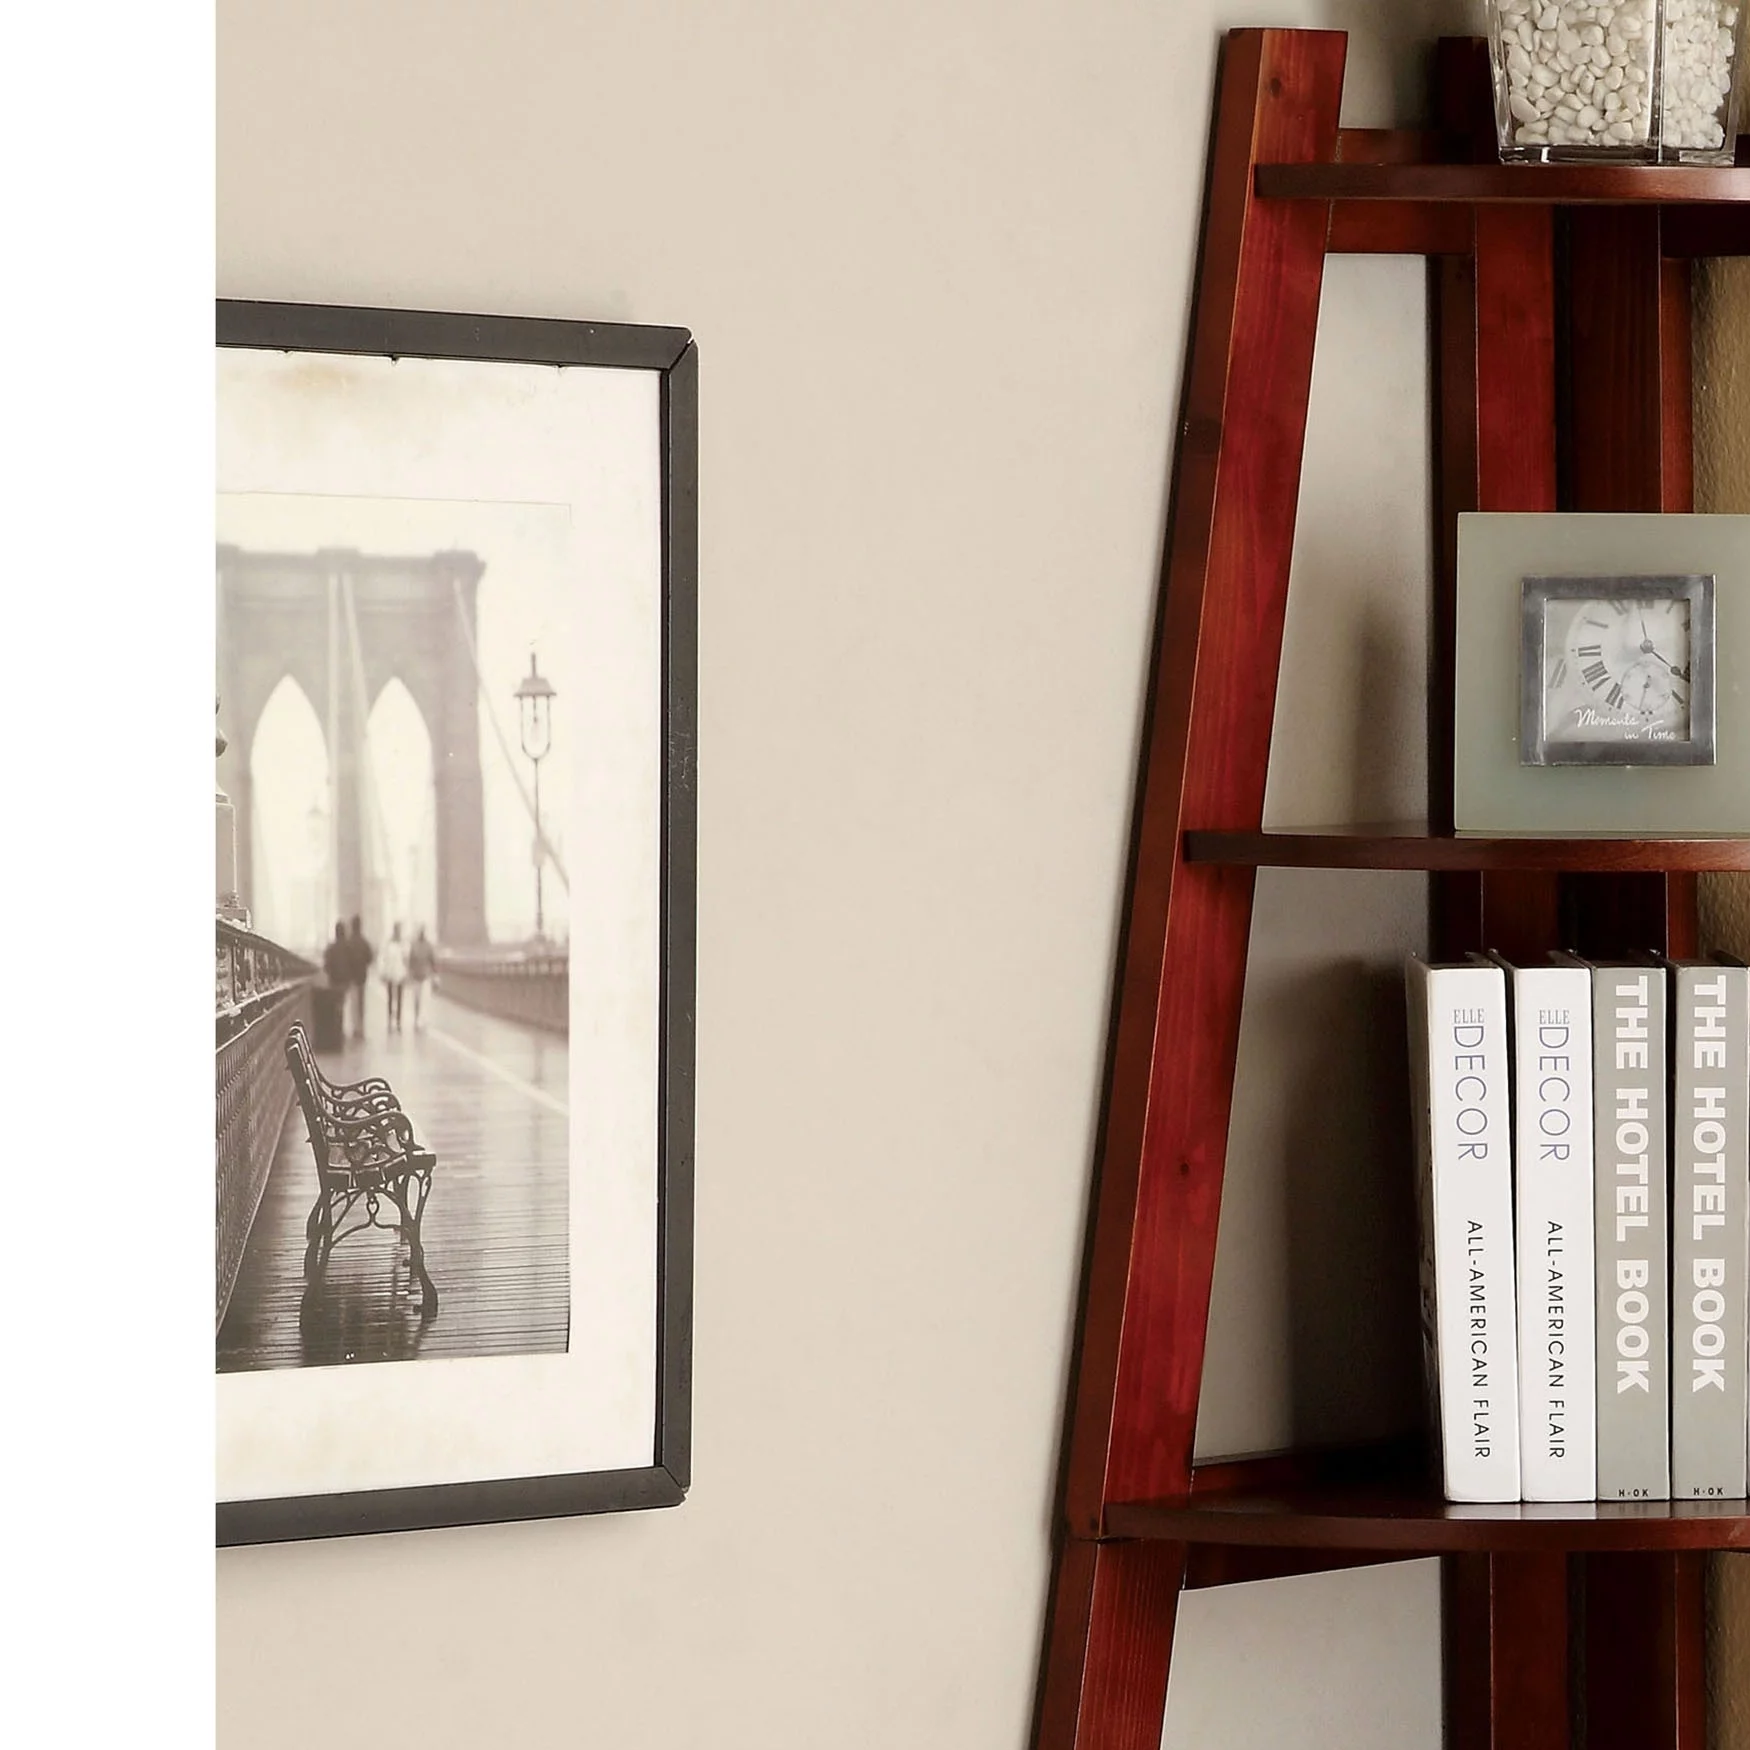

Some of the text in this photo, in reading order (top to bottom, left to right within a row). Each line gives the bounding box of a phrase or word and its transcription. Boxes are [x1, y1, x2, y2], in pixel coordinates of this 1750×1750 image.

[1453, 1008, 1485, 1024] ELLE
[1454, 1026, 1488, 1161] DECOR
[1539, 1009, 1571, 1025] ELLE
[1539, 1026, 1571, 1161] DECOR
[1615, 976, 1650, 1394] THE HOTEL BOOK
[1692, 976, 1726, 1392] THE HOTEL BOOK
[1467, 1220, 1490, 1459] ALL-AMERICAN FLAIR
[1548, 1220, 1565, 1459] ALL-AMERICAN FLAIR
